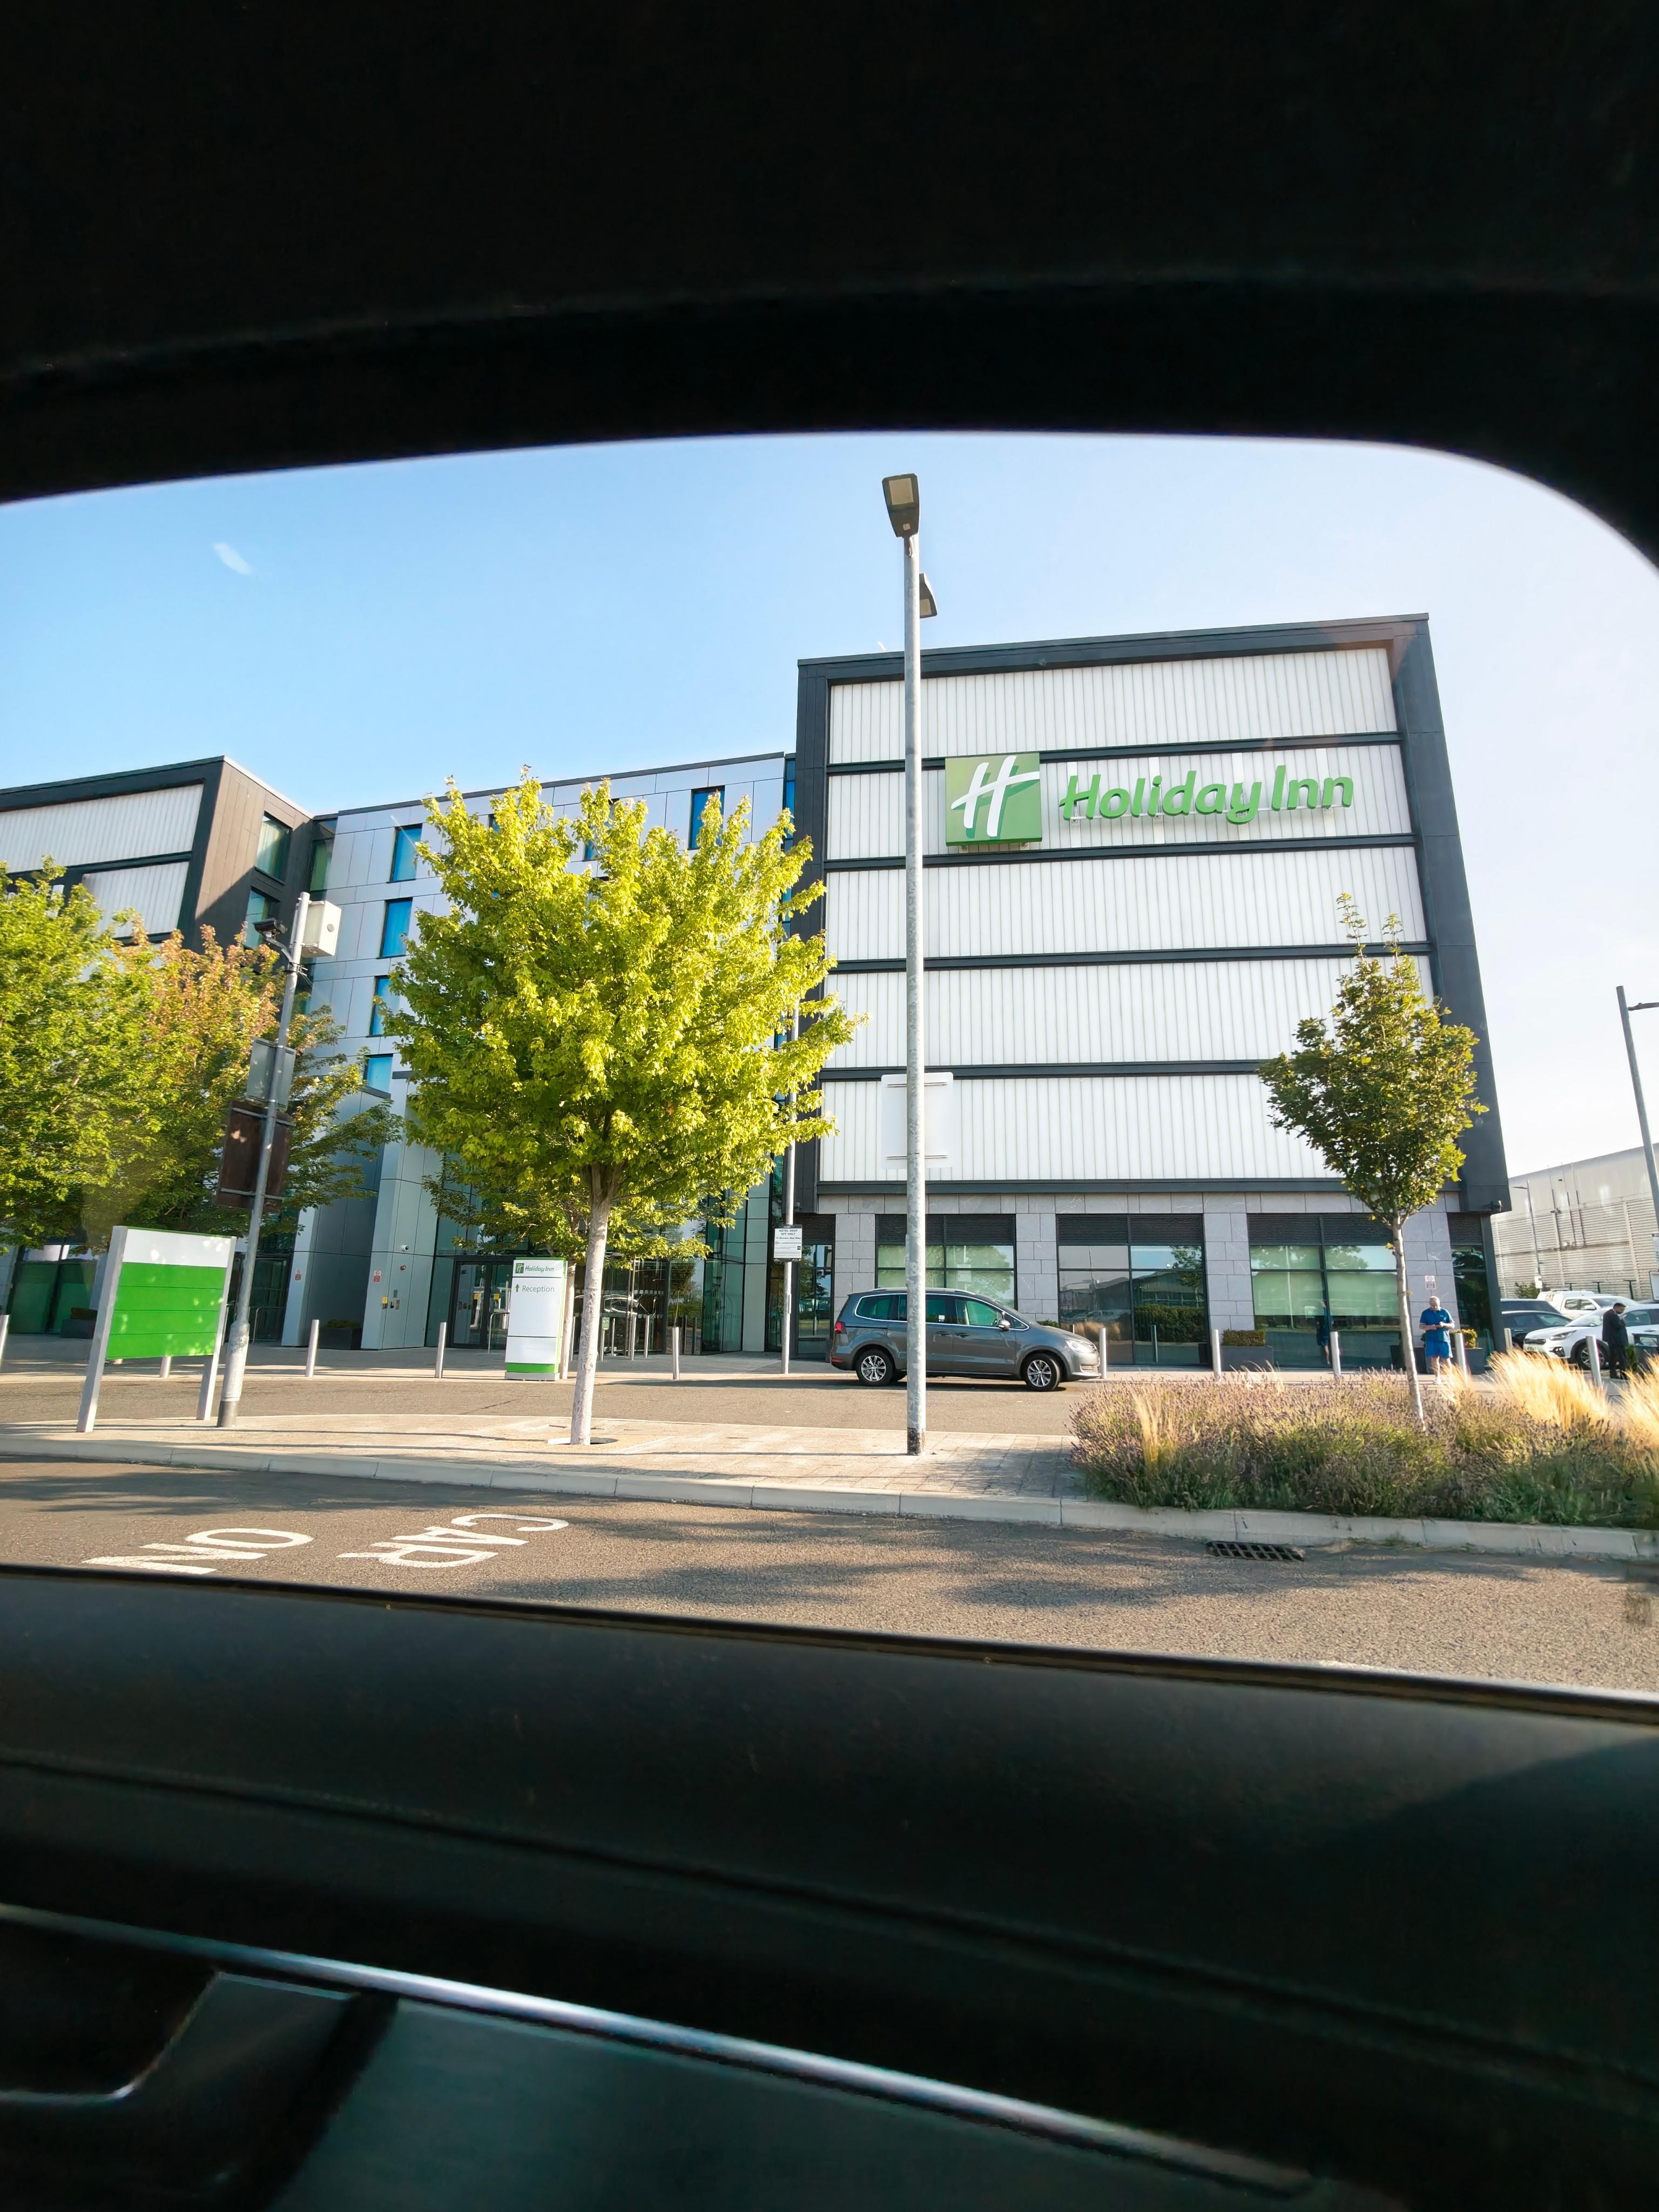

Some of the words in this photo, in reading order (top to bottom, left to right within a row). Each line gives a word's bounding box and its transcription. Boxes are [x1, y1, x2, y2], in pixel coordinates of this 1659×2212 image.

[1059, 770, 1262, 825] Holiday
[1271, 765, 1353, 811] Inn
[522, 1285, 555, 1293] Reception
[336, 1513, 569, 1568] CAR
